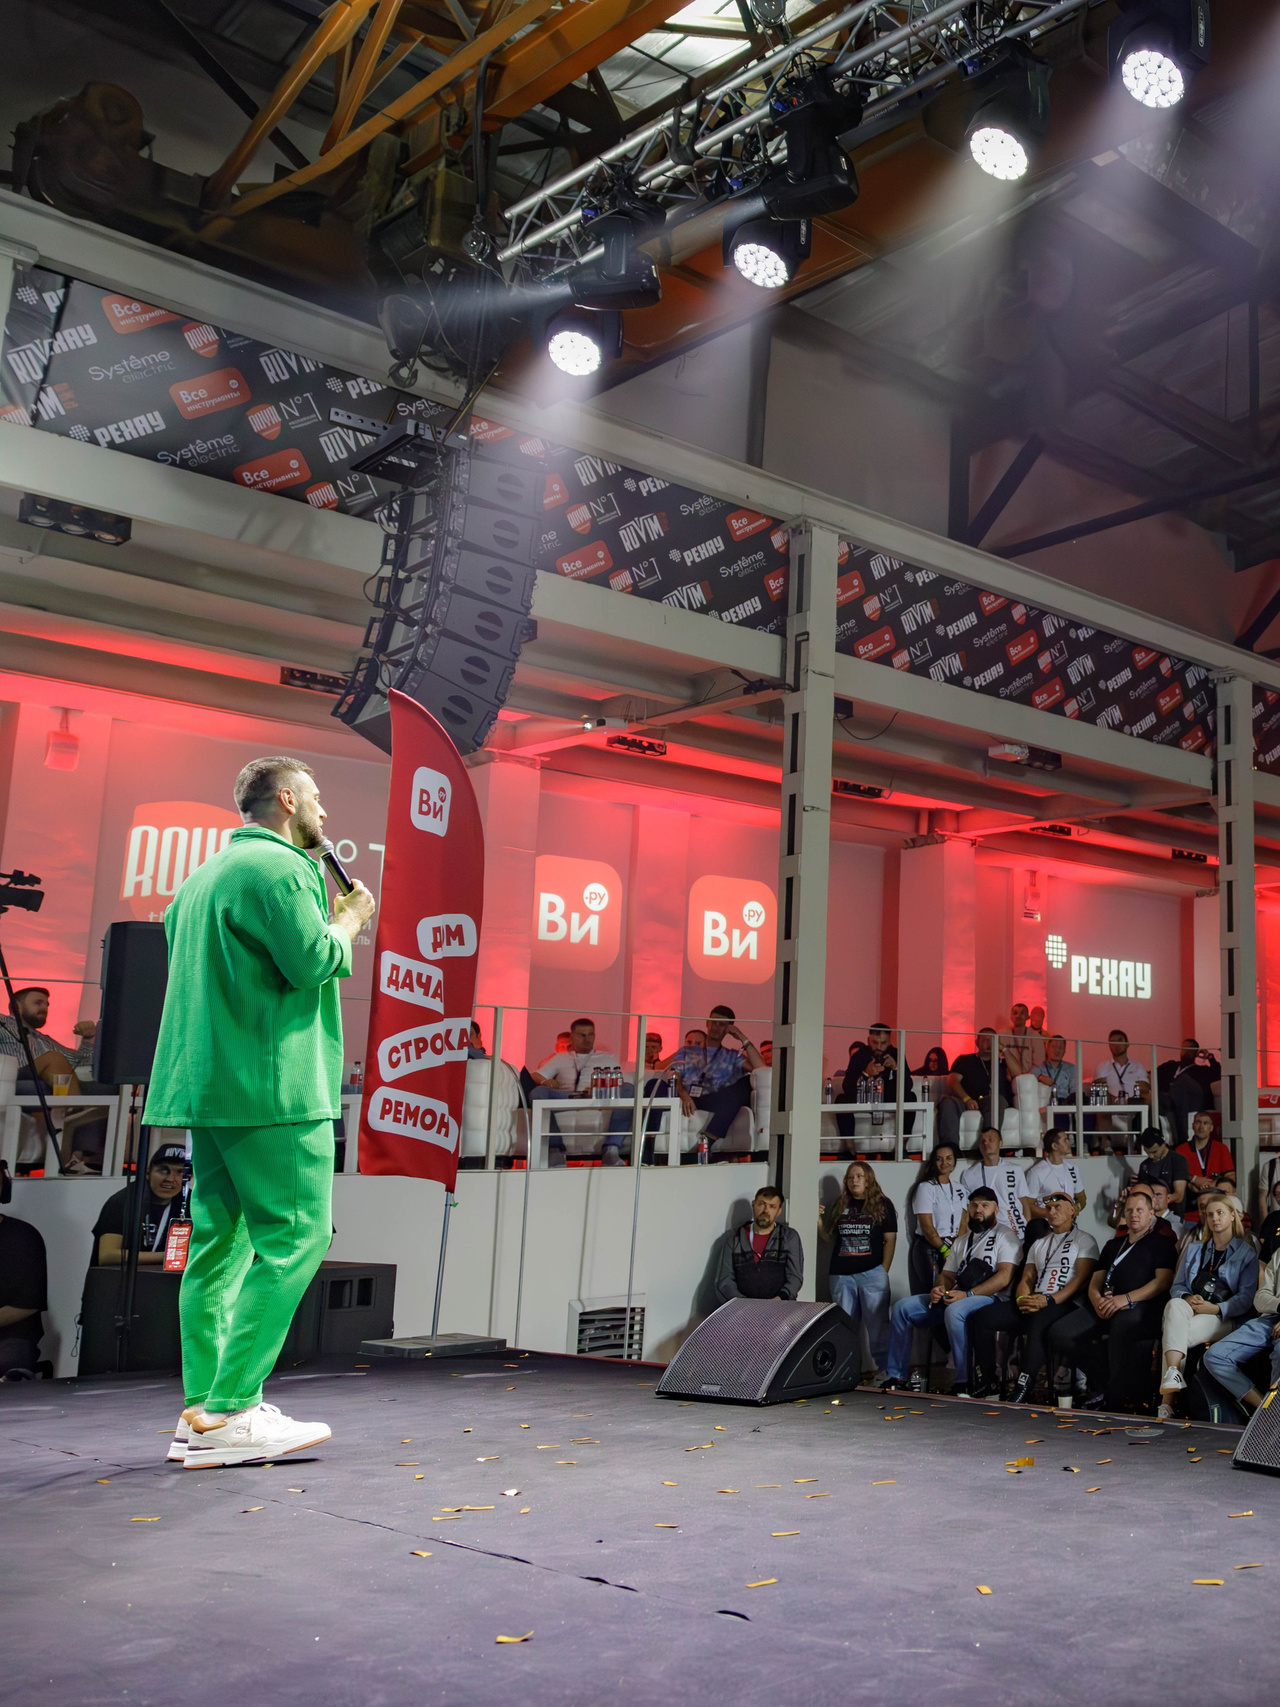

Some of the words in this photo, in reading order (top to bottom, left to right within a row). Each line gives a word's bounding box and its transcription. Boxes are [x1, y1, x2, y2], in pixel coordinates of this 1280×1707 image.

[112, 302, 142, 319] Все
[88, 351, 170, 381] Système
[179, 389, 208, 404] Все
[187, 391, 241, 412] инструменты
[94, 411, 166, 448] РЕХАУ
[157, 434, 234, 465] Système
[242, 469, 269, 486] Все
[731, 516, 749, 530] Все
[683, 535, 726, 567] РЕХАУ
[562, 560, 583, 574] Все
[719, 551, 765, 578] Système
[768, 577, 785, 590] Все
[981, 595, 996, 606] Все
[858, 643, 874, 655] Все
[1009, 645, 1022, 656] Все
[1035, 693, 1049, 705] Все
[418, 788, 443, 822] Ви
[537, 892, 600, 945] Ви
[431, 923, 466, 953] ДМ
[703, 910, 758, 960] Ви
[386, 963, 444, 1003] ДАЧА
[1071, 954, 1152, 999] РЕХАУ
[379, 1097, 450, 1139] РЕМОН
[1006, 1170, 1016, 1188] 101
